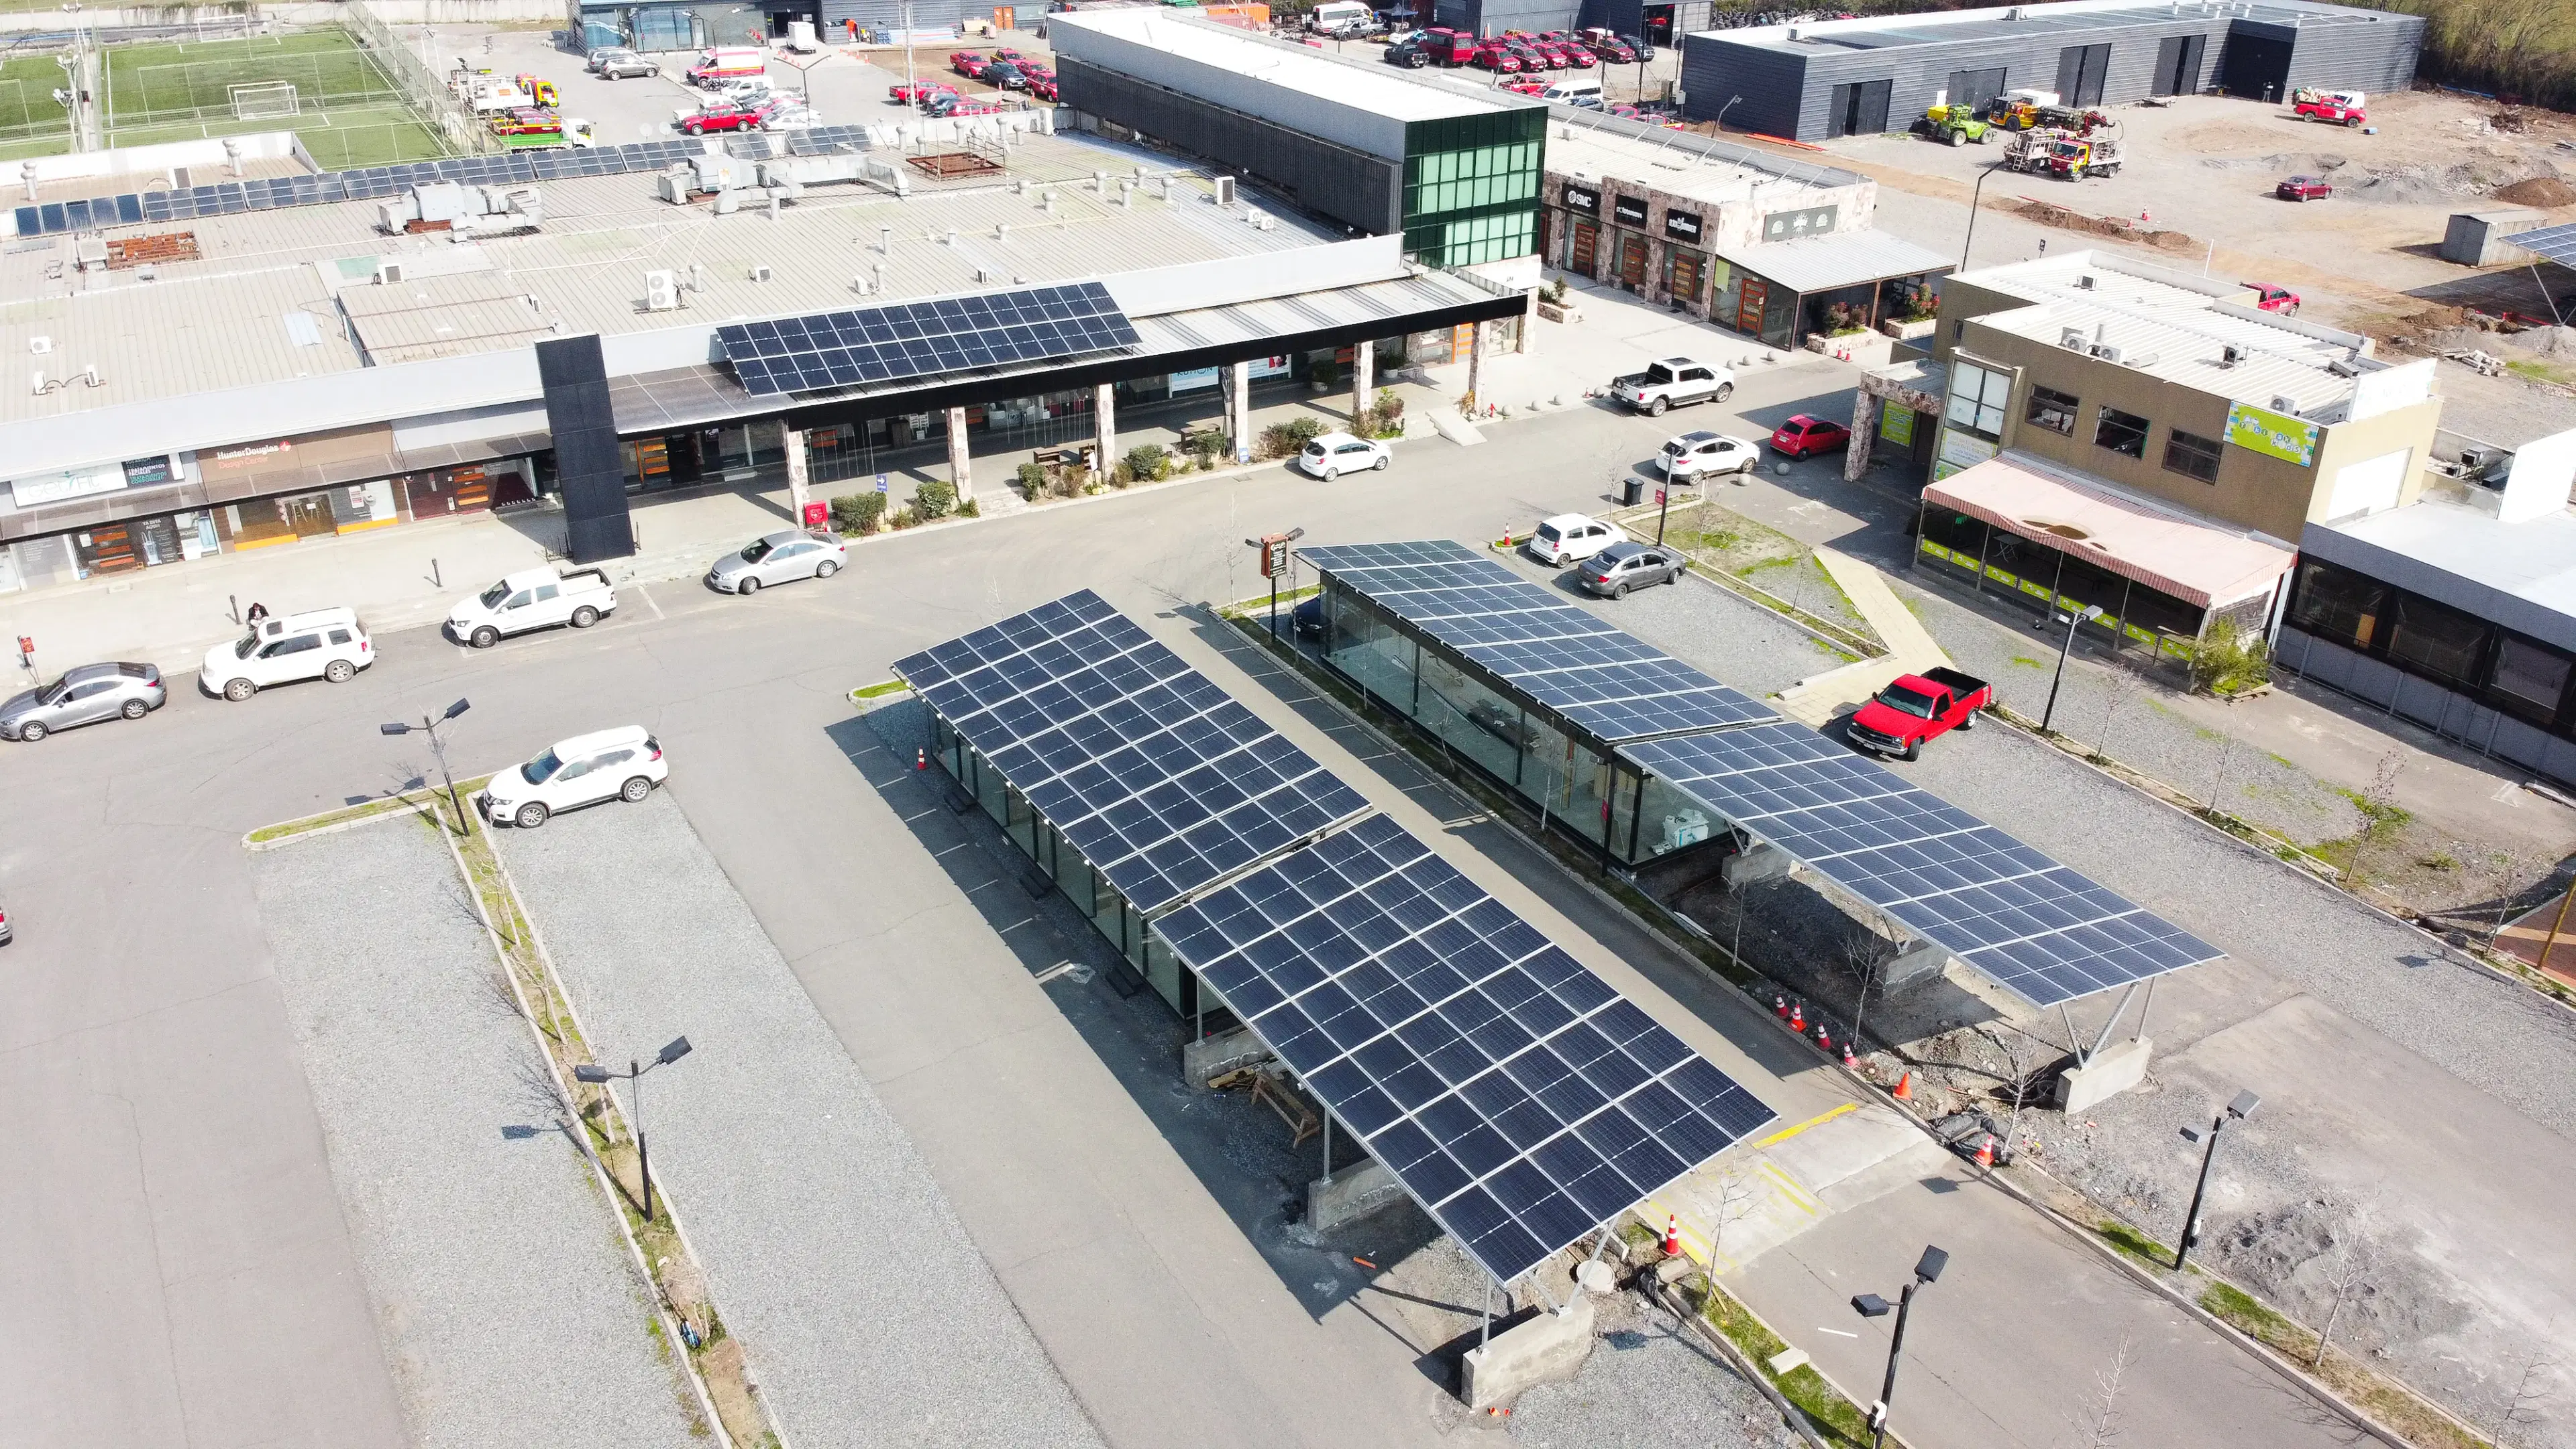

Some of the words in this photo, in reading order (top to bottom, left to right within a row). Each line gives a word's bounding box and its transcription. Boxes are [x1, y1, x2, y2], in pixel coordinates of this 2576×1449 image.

[1576, 193, 1592, 207] SMC
[219, 460, 244, 469] Design
[244, 456, 268, 465] Center
